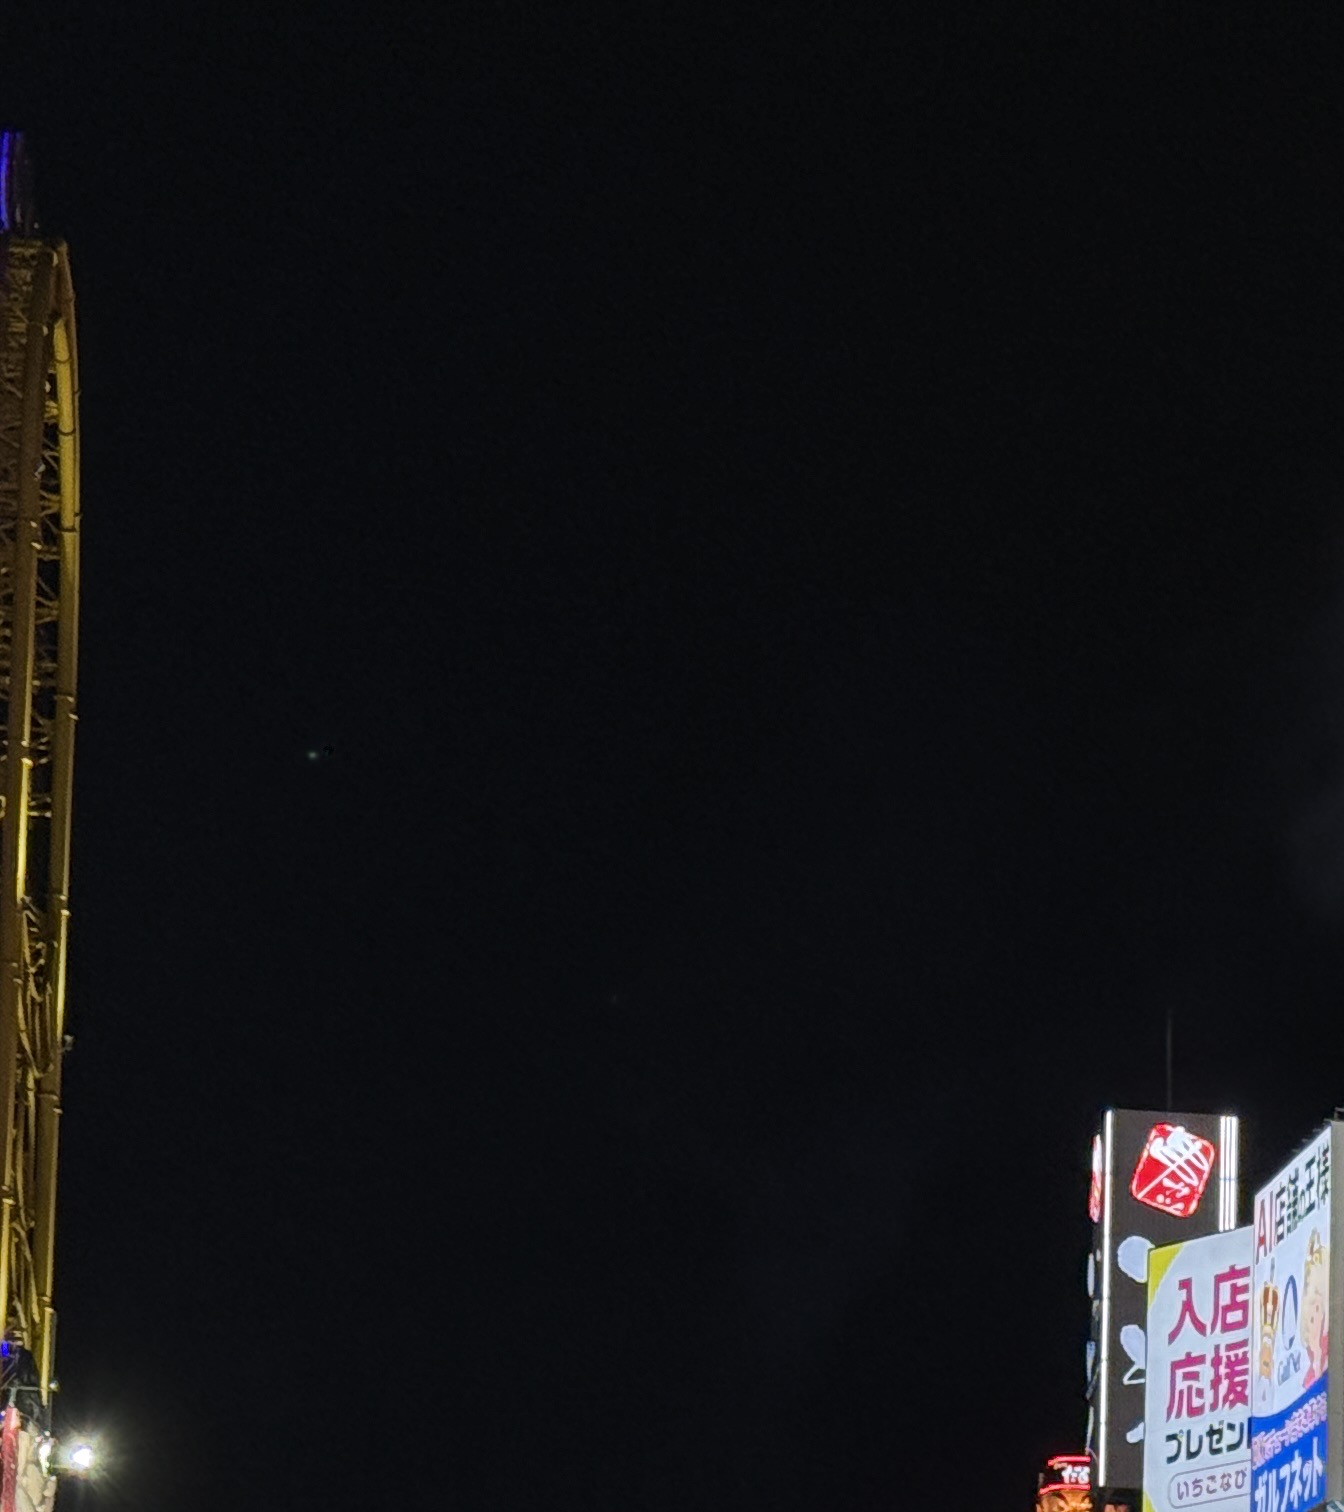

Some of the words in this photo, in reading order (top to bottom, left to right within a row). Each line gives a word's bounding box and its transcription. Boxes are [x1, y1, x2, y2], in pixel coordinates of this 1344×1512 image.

[1167, 1263, 1251, 1347] 入店
[1165, 1338, 1250, 1424] 応援
[1165, 1421, 1252, 1465] プレゼン
